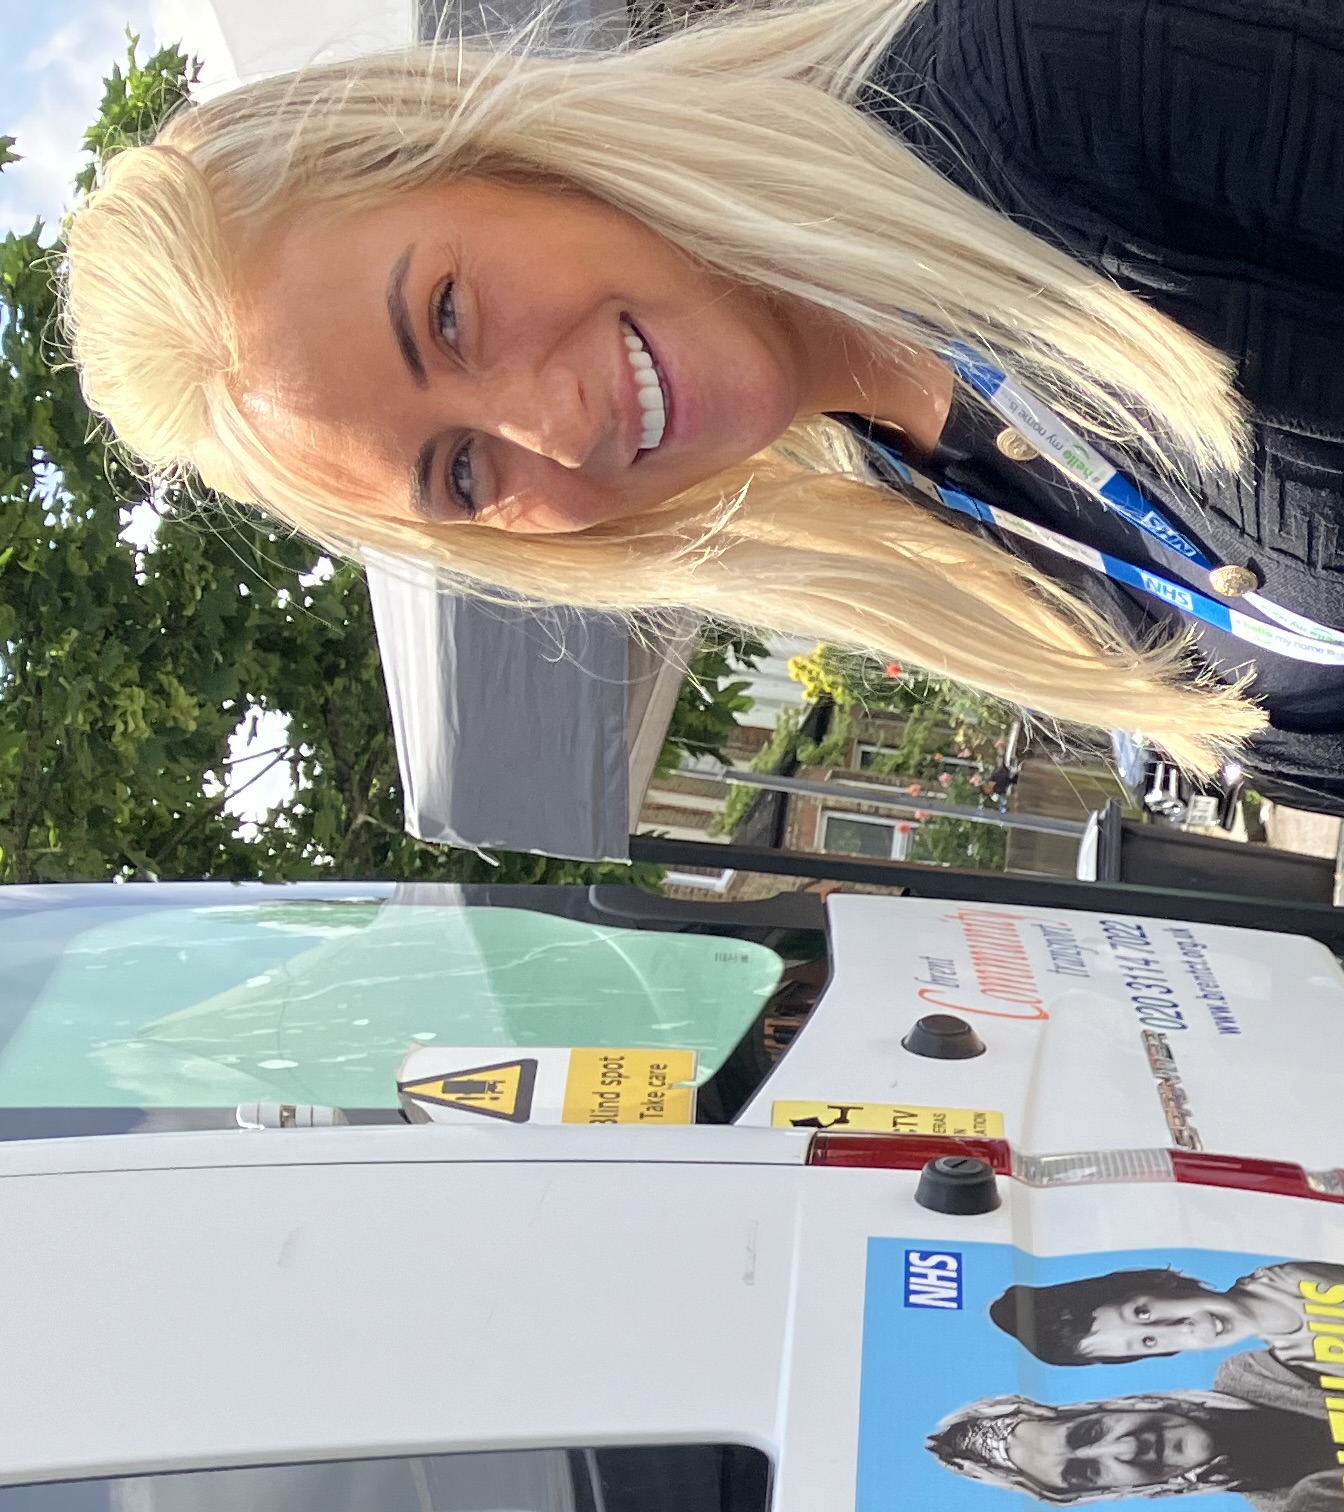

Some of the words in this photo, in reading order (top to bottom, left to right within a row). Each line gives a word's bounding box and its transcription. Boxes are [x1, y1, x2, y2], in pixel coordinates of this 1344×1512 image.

[1016, 407, 1047, 439] name
[1046, 432, 1065, 451] my
[1146, 511, 1194, 555] NHS
[1143, 574, 1191, 609] NHS
[1030, 923, 1099, 978] transport
[1099, 920, 1155, 954] 7022
[918, 907, 1068, 1020] Community
[1114, 955, 1174, 994] 3114
[1163, 927, 1241, 1035] www.brentct.org.uk
[1130, 995, 1188, 1030] 020
[598, 1056, 630, 1086] spot
[645, 1063, 668, 1088] care
[639, 1090, 665, 1120] Take
[1140, 1029, 1203, 1151] SPRINTER
[907, 1252, 960, 1307] NHS
